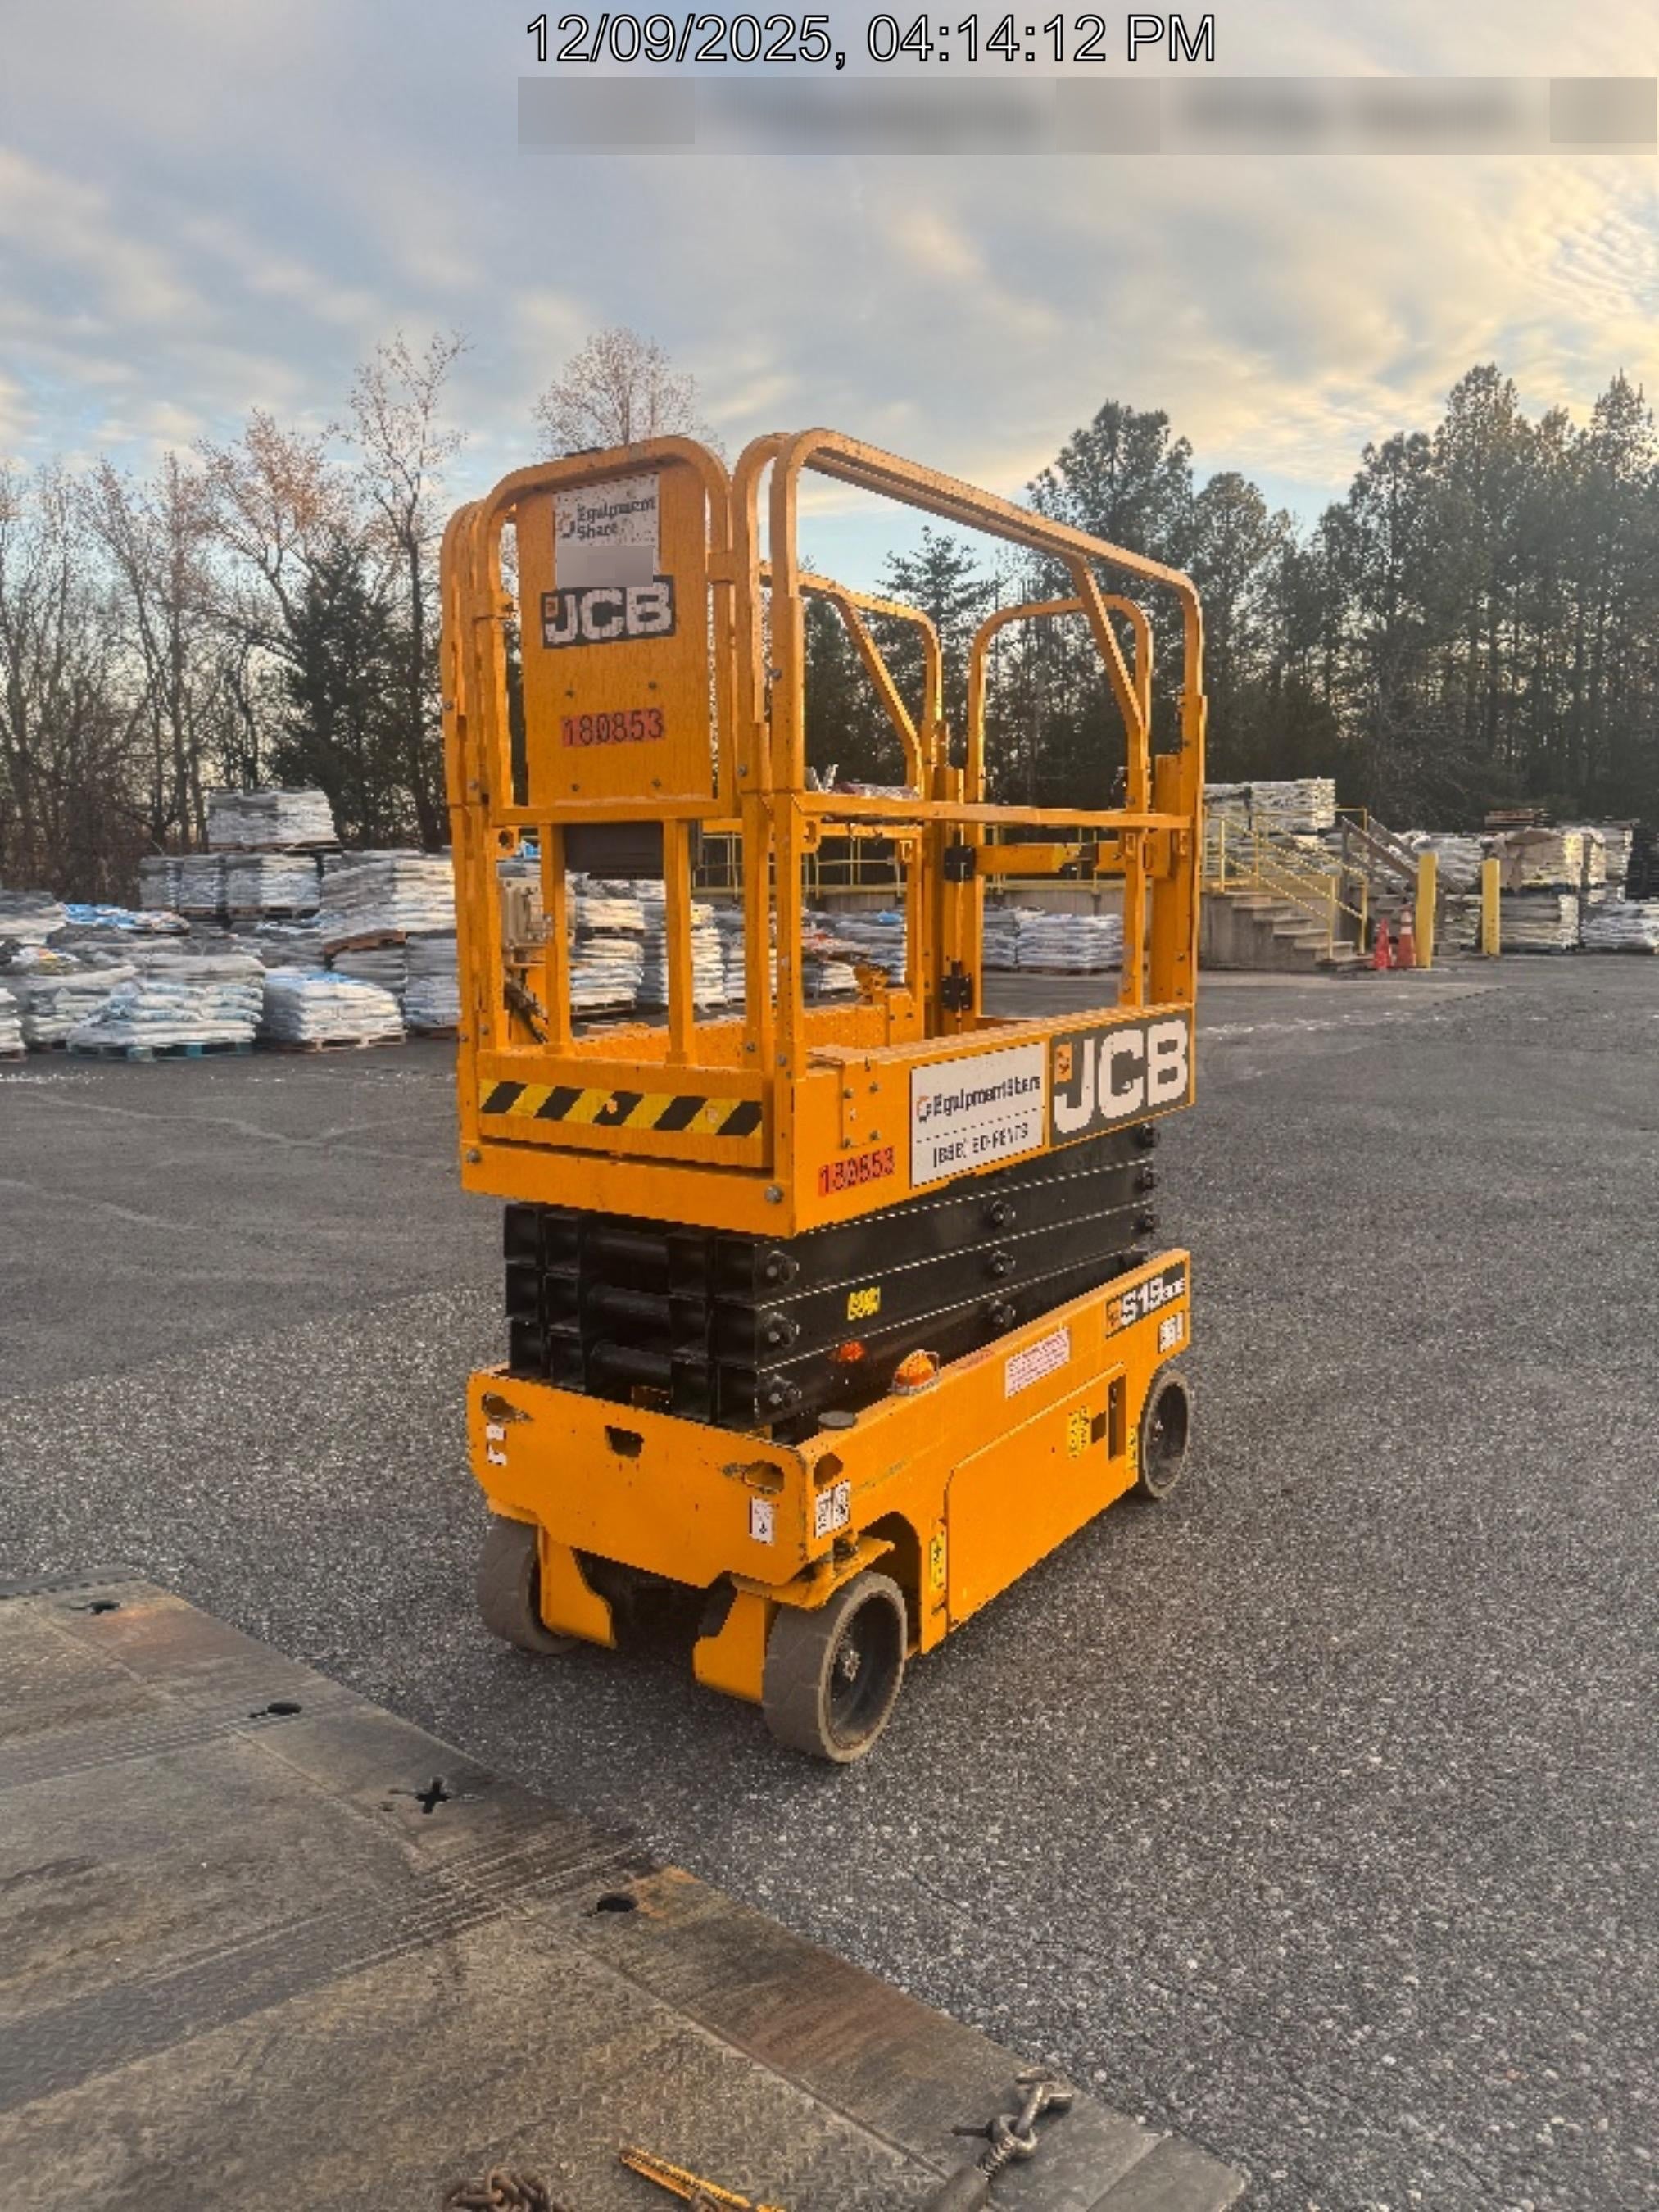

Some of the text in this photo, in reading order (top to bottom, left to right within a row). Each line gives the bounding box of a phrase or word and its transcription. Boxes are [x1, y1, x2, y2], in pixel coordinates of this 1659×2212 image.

[545, 582, 672, 644] JCB
[564, 708, 664, 746] 180853
[1054, 1019, 1189, 1134] JCB
